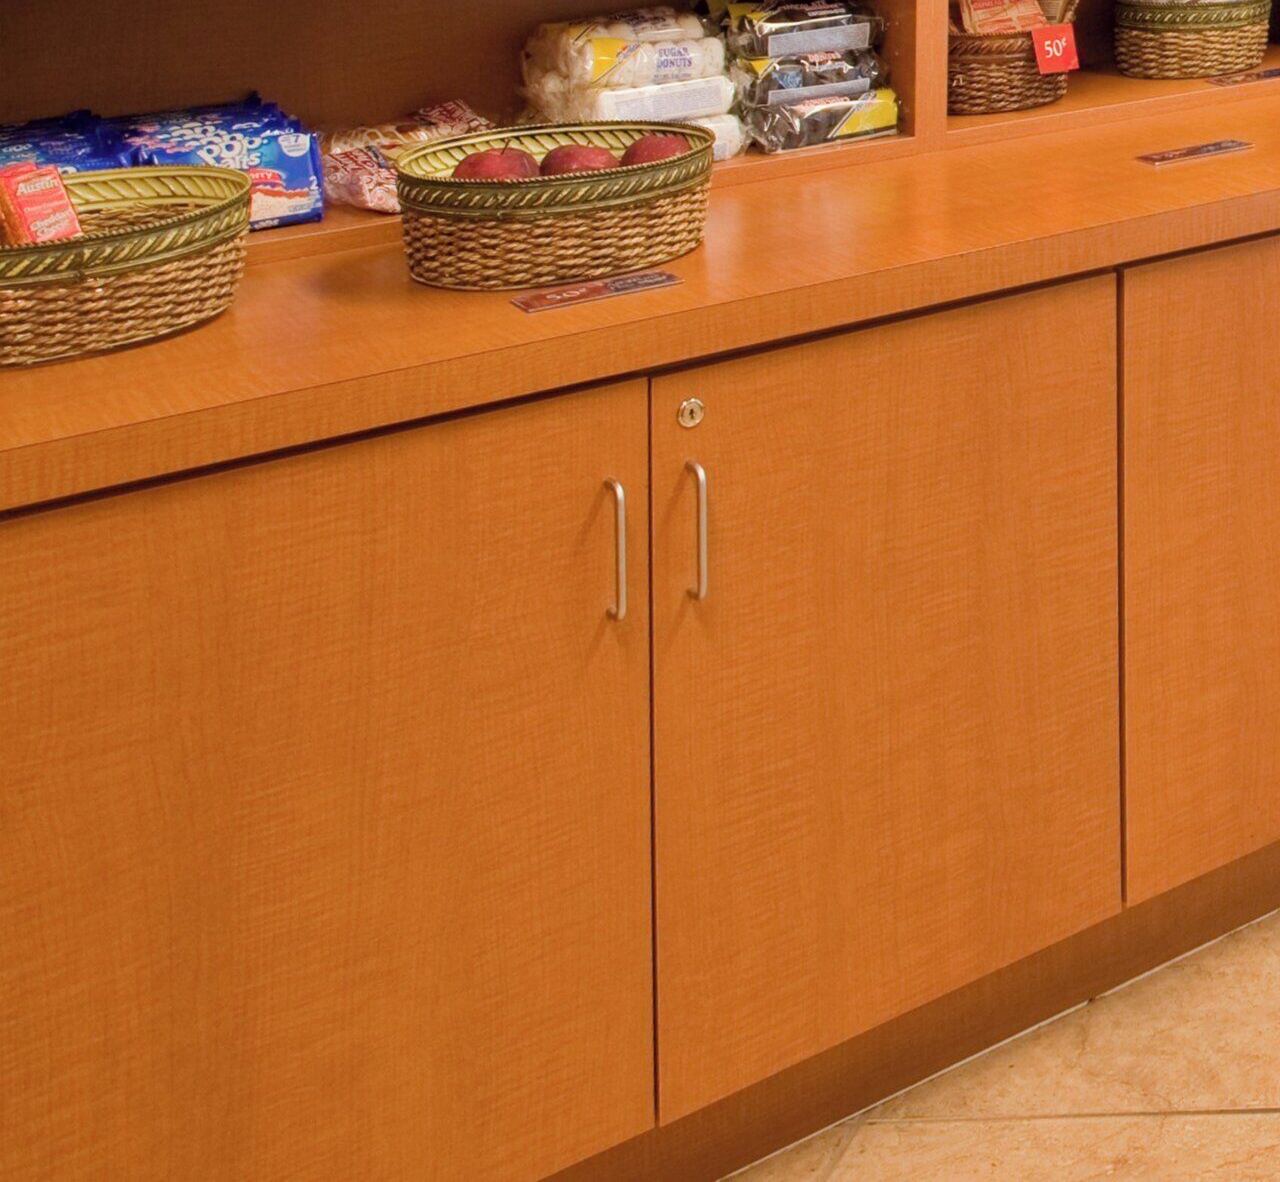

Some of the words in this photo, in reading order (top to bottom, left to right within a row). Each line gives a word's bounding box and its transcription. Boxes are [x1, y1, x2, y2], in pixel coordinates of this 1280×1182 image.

[657, 46, 689, 58] SUGAR
[1044, 36, 1068, 58] 50¢
[656, 57, 693, 69] DONUTS
[16, 178, 58, 197] Austin
